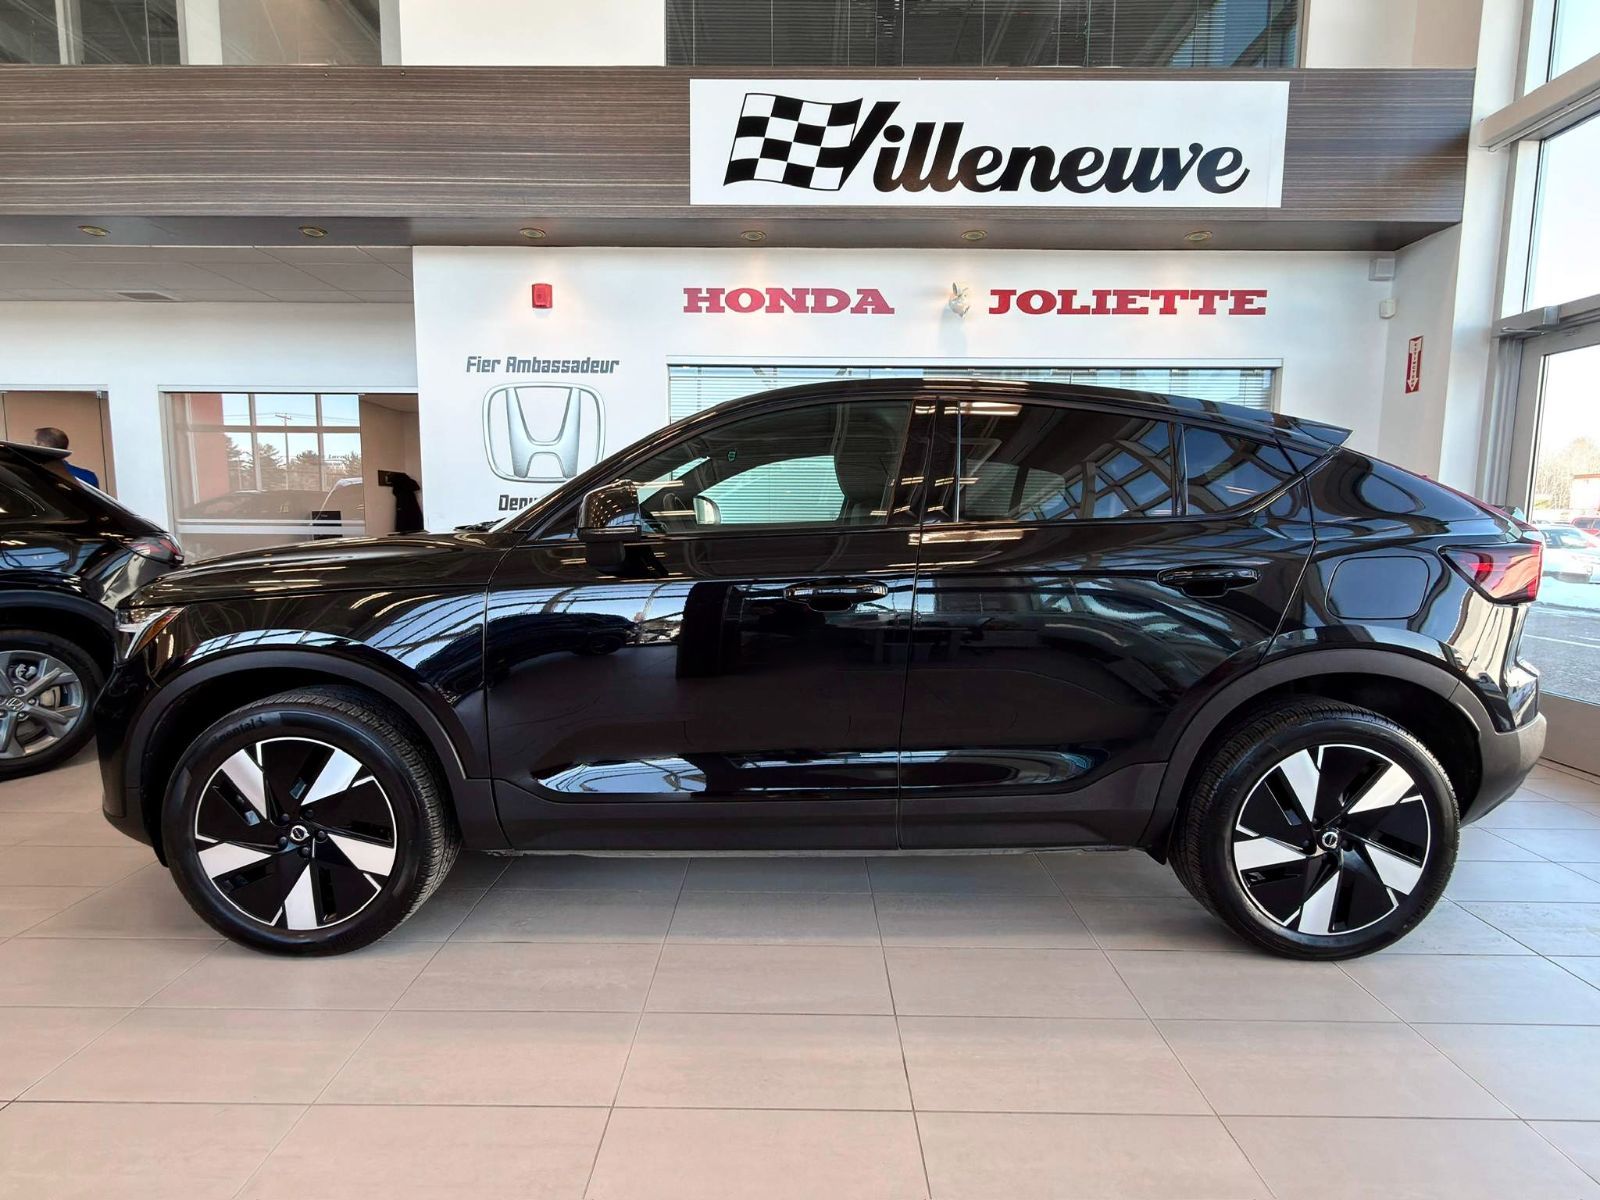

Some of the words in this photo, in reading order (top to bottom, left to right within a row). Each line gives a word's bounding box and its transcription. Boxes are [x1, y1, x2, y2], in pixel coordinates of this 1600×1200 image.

[838, 99, 1251, 194] Villeneuve
[683, 287, 895, 315] HONDA
[988, 289, 1267, 316] JOLIETTE
[466, 356, 501, 374] Fier
[505, 356, 620, 374] Ambassadeur
